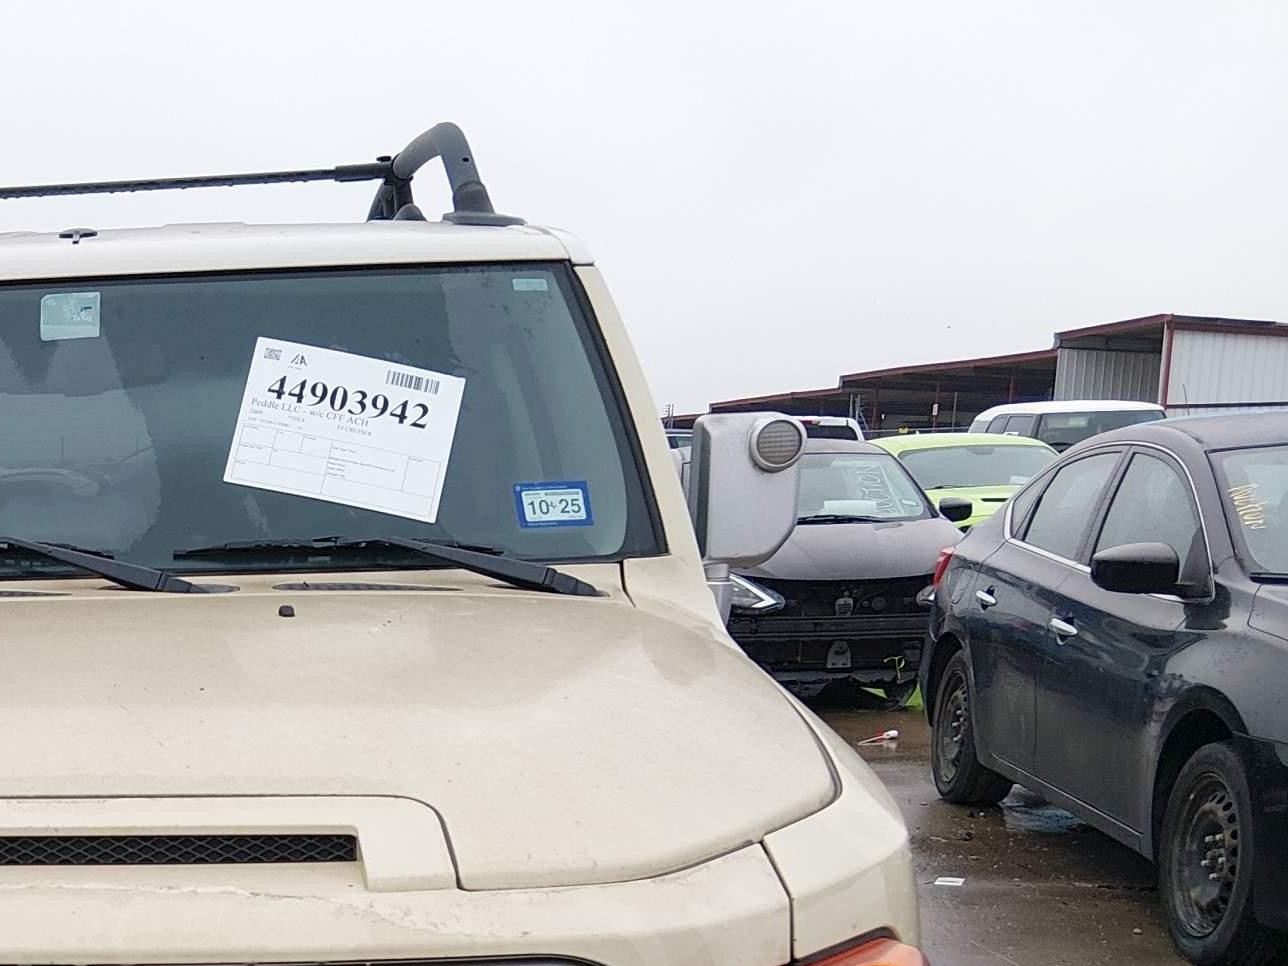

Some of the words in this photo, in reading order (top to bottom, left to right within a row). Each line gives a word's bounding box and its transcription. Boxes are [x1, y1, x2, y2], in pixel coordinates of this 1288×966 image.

[251, 398, 279, 410] Peddle
[281, 402, 301, 414] LLC
[267, 375, 430, 429] 44903942
[528, 499, 550, 515] 10
[559, 498, 581, 513] 25
